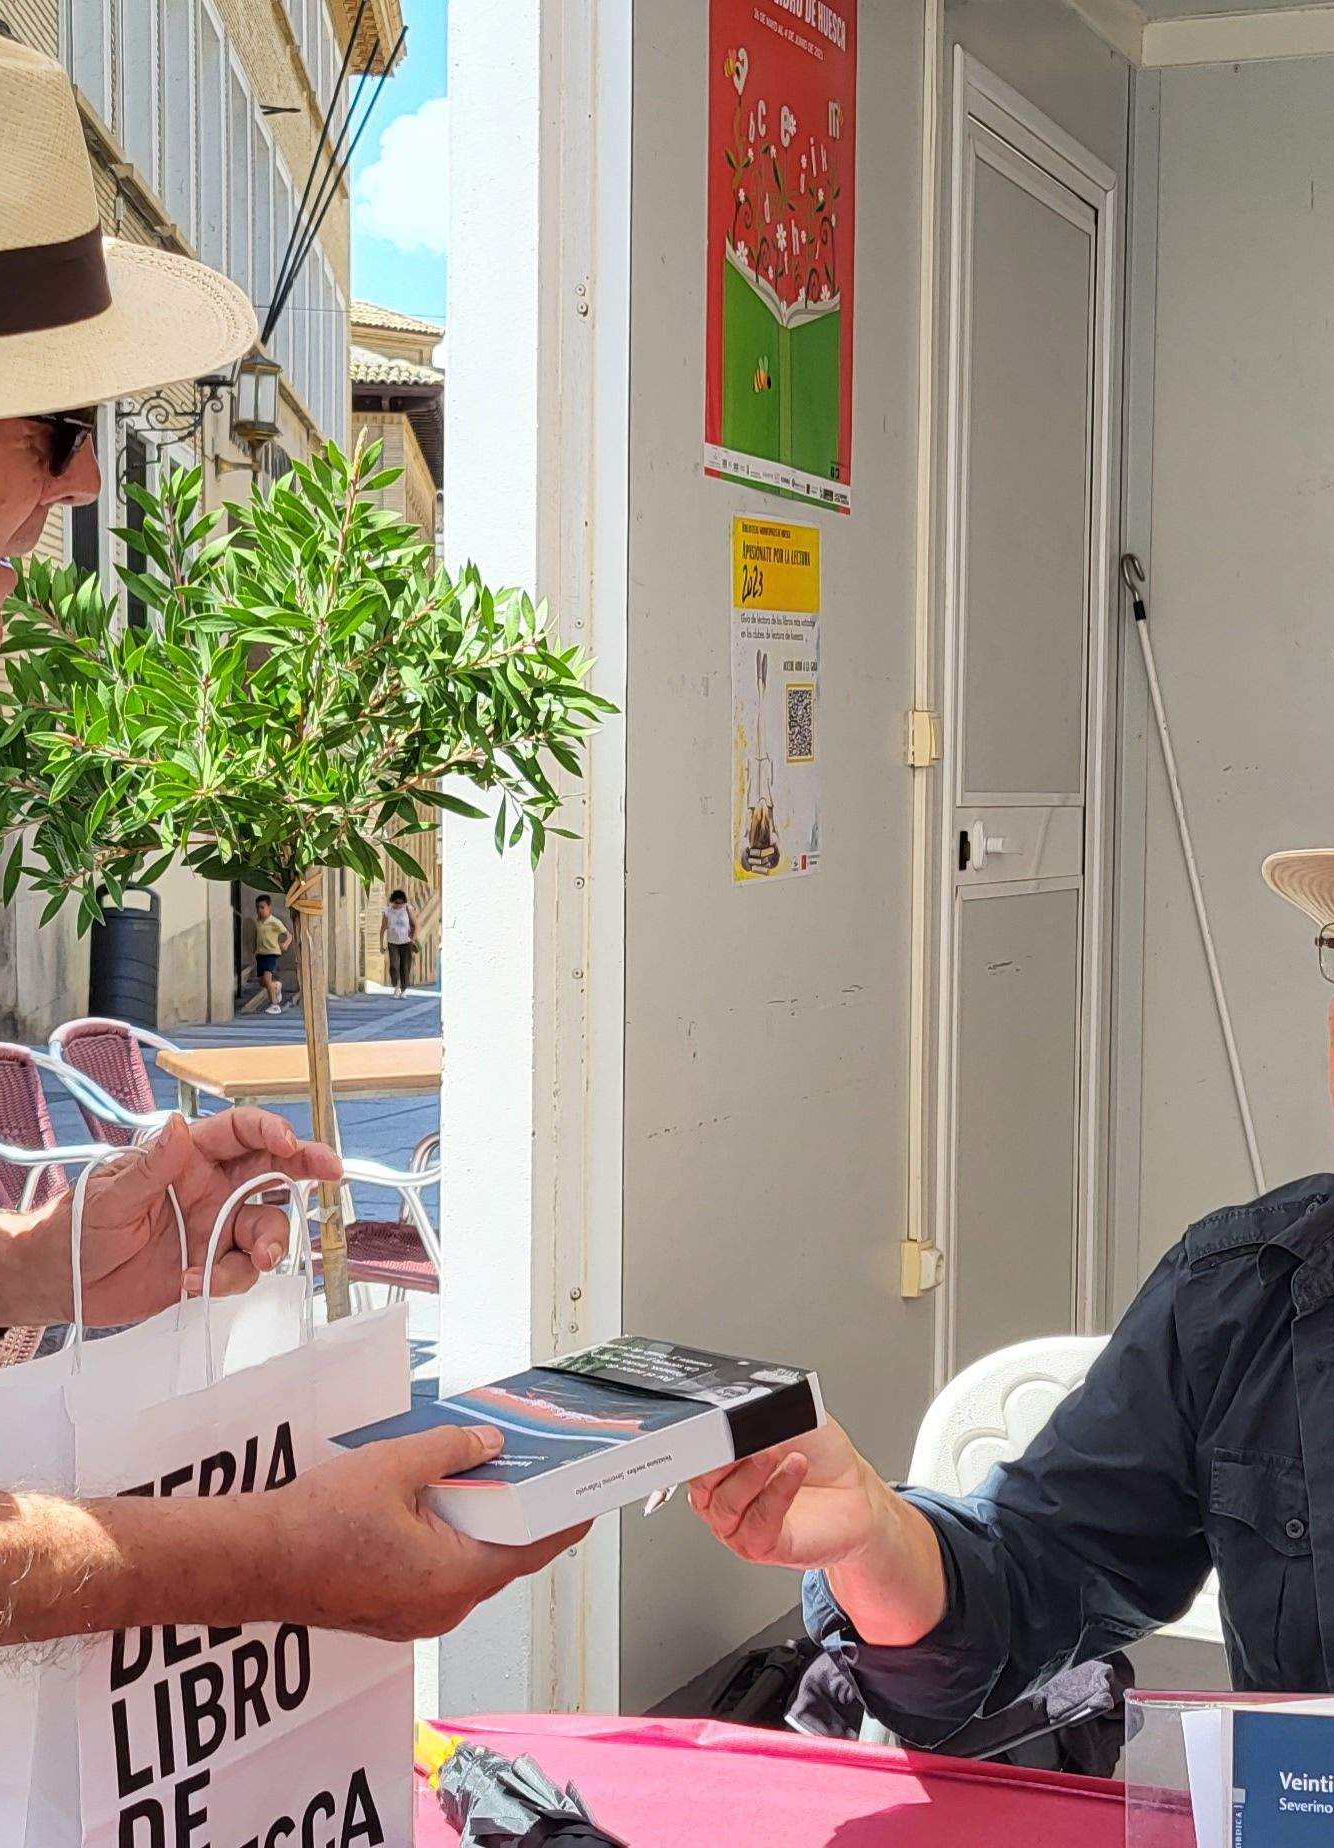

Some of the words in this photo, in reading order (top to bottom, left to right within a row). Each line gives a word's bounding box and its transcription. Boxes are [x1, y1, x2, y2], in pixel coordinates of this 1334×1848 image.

[818, 1, 846, 52] HUESCA
[742, 564, 764, 603] 2023
[116, 1421, 297, 1498] RIA
[110, 1624, 242, 1692] DE
[112, 1622, 310, 1799] LIBRO
[1279, 1797, 1333, 1815] Severino
